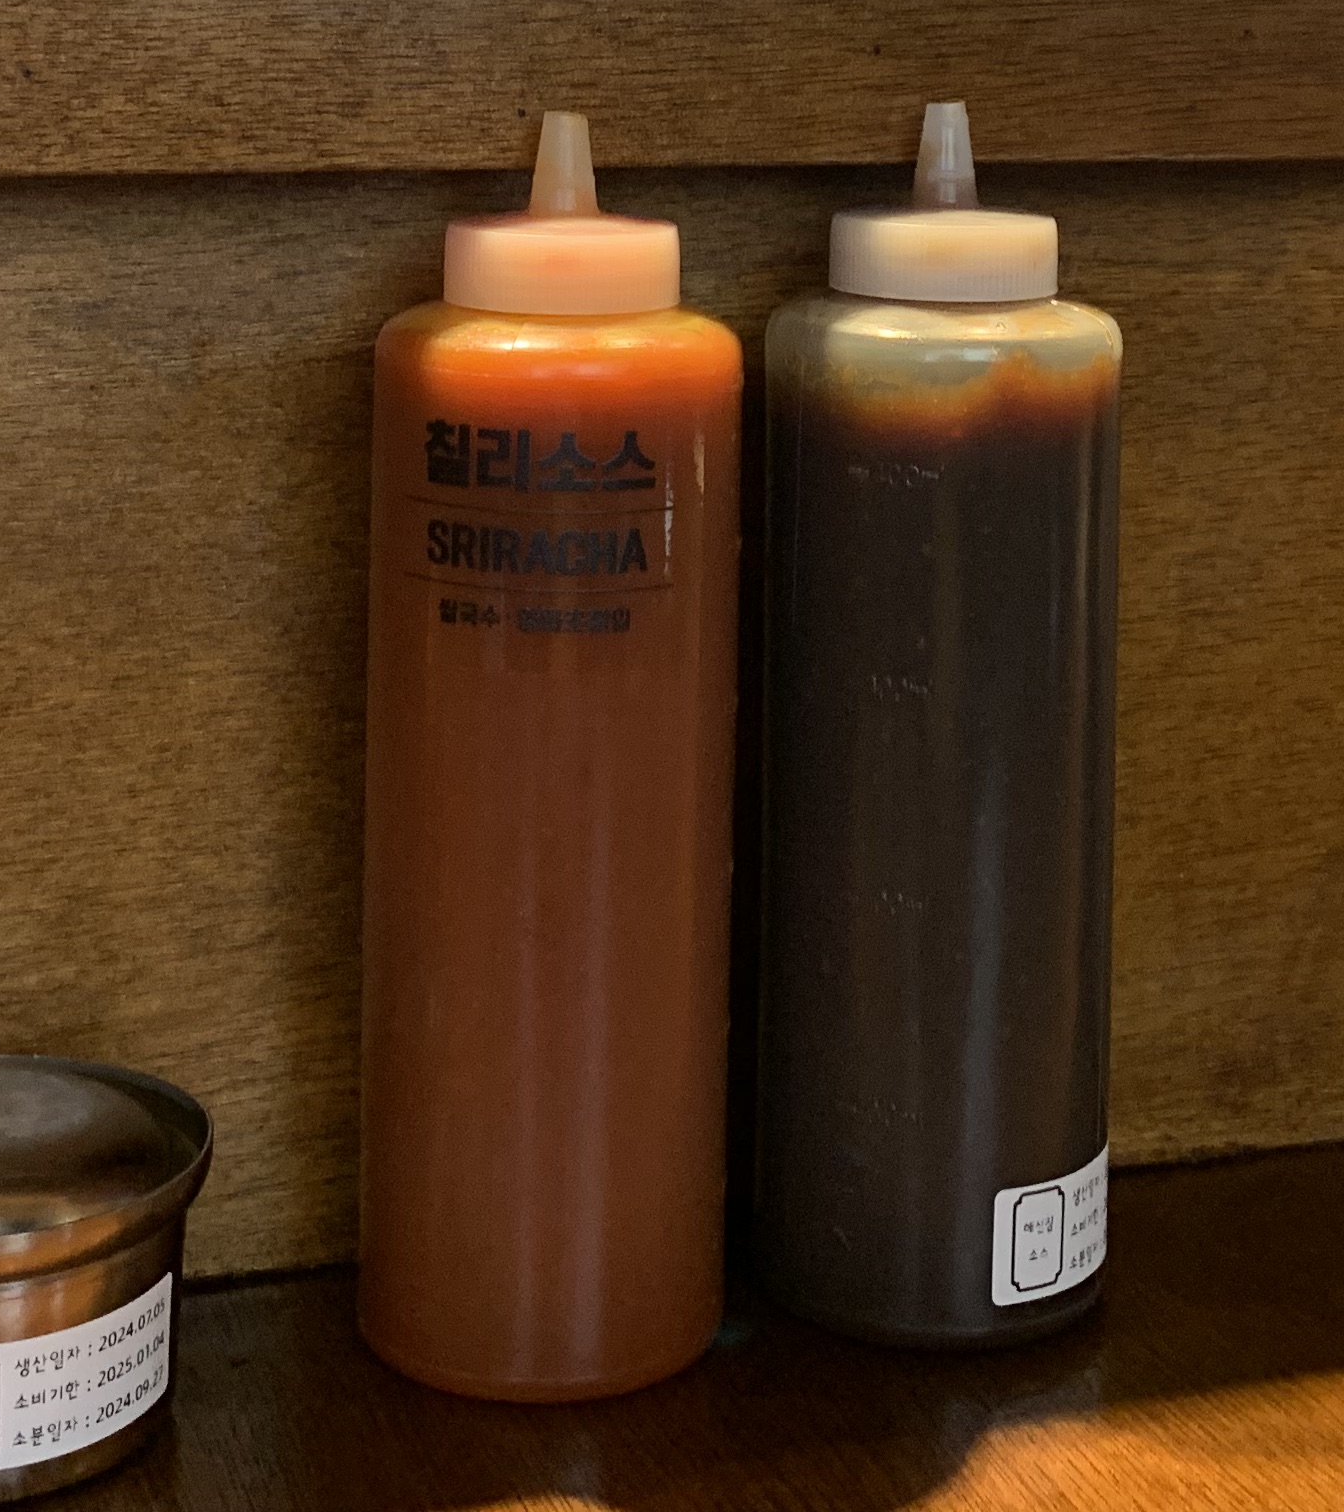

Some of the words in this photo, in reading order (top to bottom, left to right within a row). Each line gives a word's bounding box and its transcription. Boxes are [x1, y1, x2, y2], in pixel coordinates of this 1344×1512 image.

[424, 418, 657, 493] 칠리소스
[425, 518, 649, 576] SRIRACHA
[14, 1345, 81, 1377] 생산일자
[97, 1297, 166, 1352] 2024.07.05
[13, 1380, 80, 1410] 소비기한
[11, 1416, 79, 1447] 소분일자
